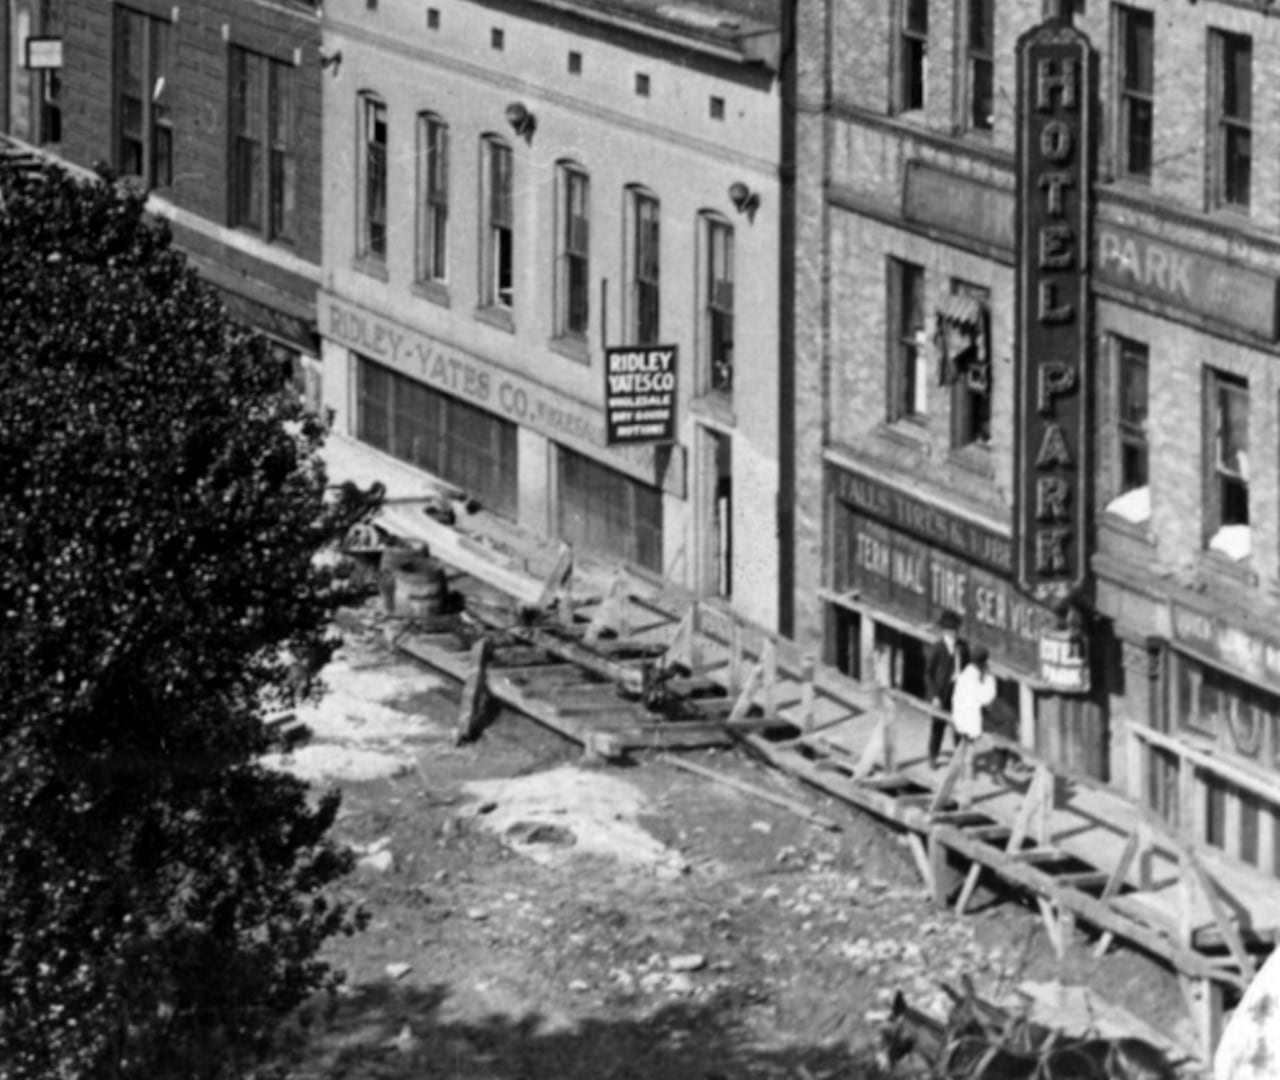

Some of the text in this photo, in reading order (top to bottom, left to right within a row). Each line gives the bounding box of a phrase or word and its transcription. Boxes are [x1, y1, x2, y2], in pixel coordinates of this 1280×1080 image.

[1036, 56, 1077, 322] HOTEL
[1099, 231, 1190, 300] PARK
[328, 303, 491, 401] RIDLEY-YATES
[609, 351, 673, 372] RIDLEY
[1036, 360, 1077, 573] PARK
[856, 531, 926, 594] TERMINAL
[929, 562, 968, 616] TIRE
